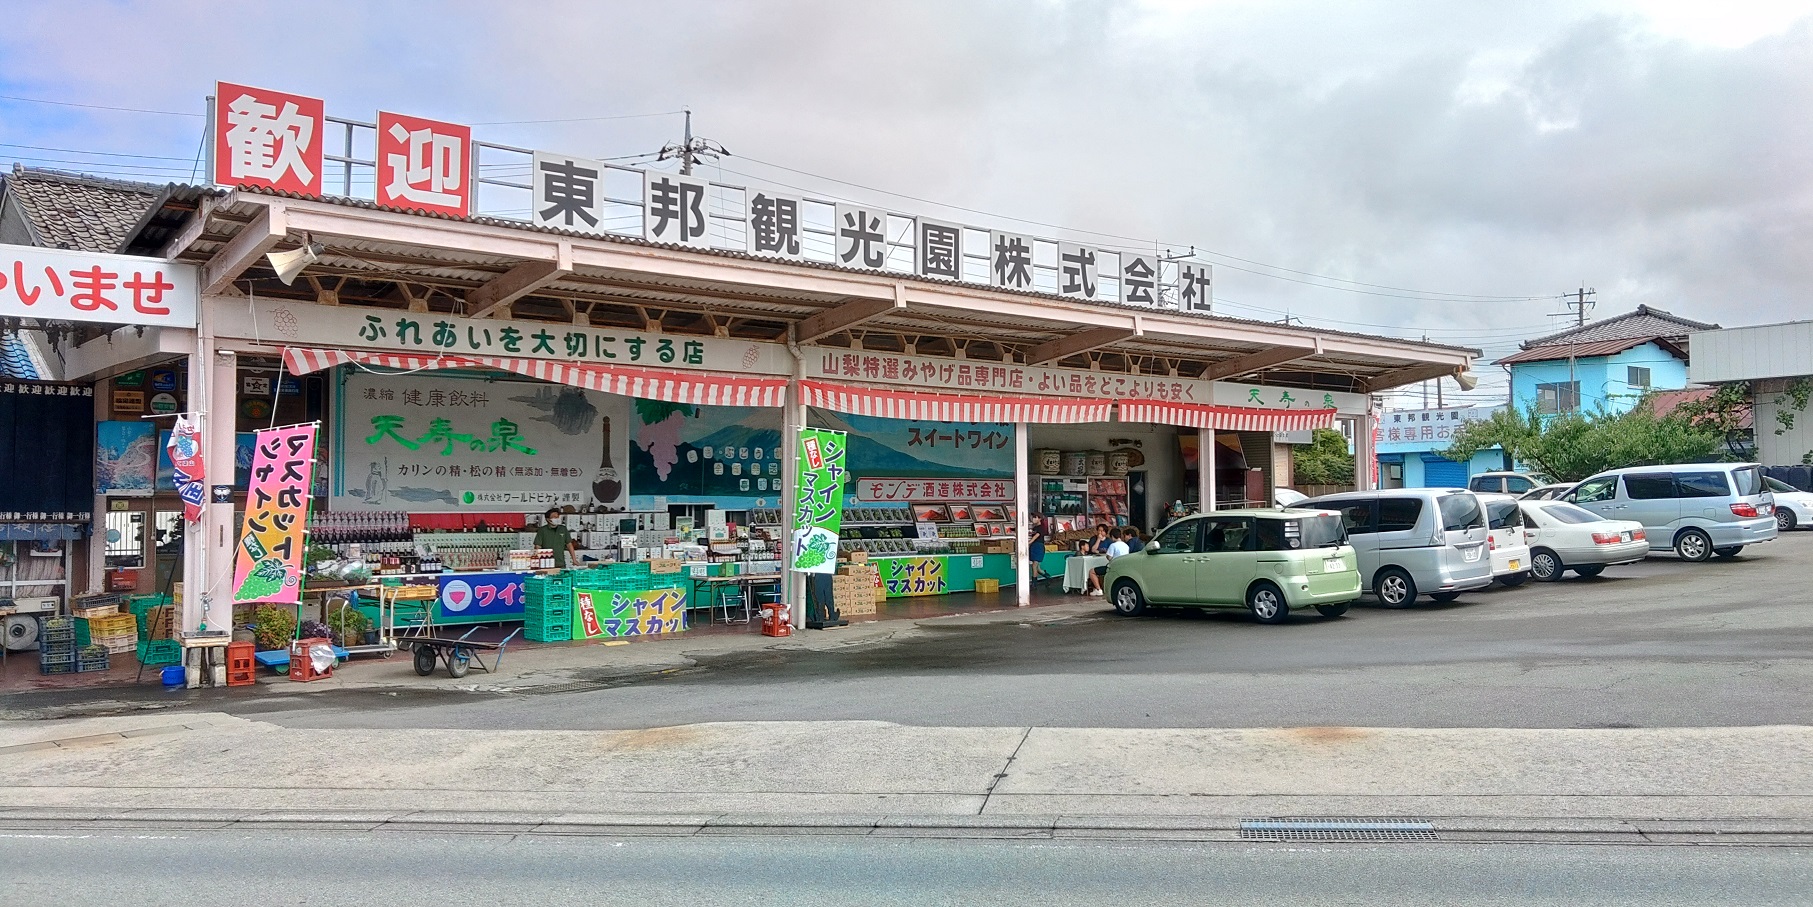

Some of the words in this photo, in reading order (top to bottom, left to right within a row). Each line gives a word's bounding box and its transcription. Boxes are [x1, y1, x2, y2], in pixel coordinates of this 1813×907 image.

[227, 93, 462, 208] 歓迎
[539, 159, 1211, 312] 東邦観光園株式会社
[0, 260, 174, 315] いませ
[358, 314, 705, 365] ふれあいを大切にする店
[822, 352, 1194, 401] 山梨特選みやげ品専門店・よい品をどこよりも安く
[364, 387, 395, 401] 濃縮
[401, 388, 490, 408] 健康飲料
[1248, 388, 1338, 409] 天寿の泉
[1393, 411, 1459, 423] 東邦観光園
[365, 414, 539, 457] 天寿の泉
[907, 427, 1009, 450] スイートワイン
[806, 440, 821, 468] 種なし
[814, 440, 845, 523] シャイン
[870, 481, 1006, 499] モンデ酒造株式会社
[796, 471, 819, 557] マスカット
[891, 559, 942, 577] シャイン
[886, 576, 947, 594] マスカット
[580, 596, 599, 635] 種なし
[611, 591, 687, 617] シャイン
